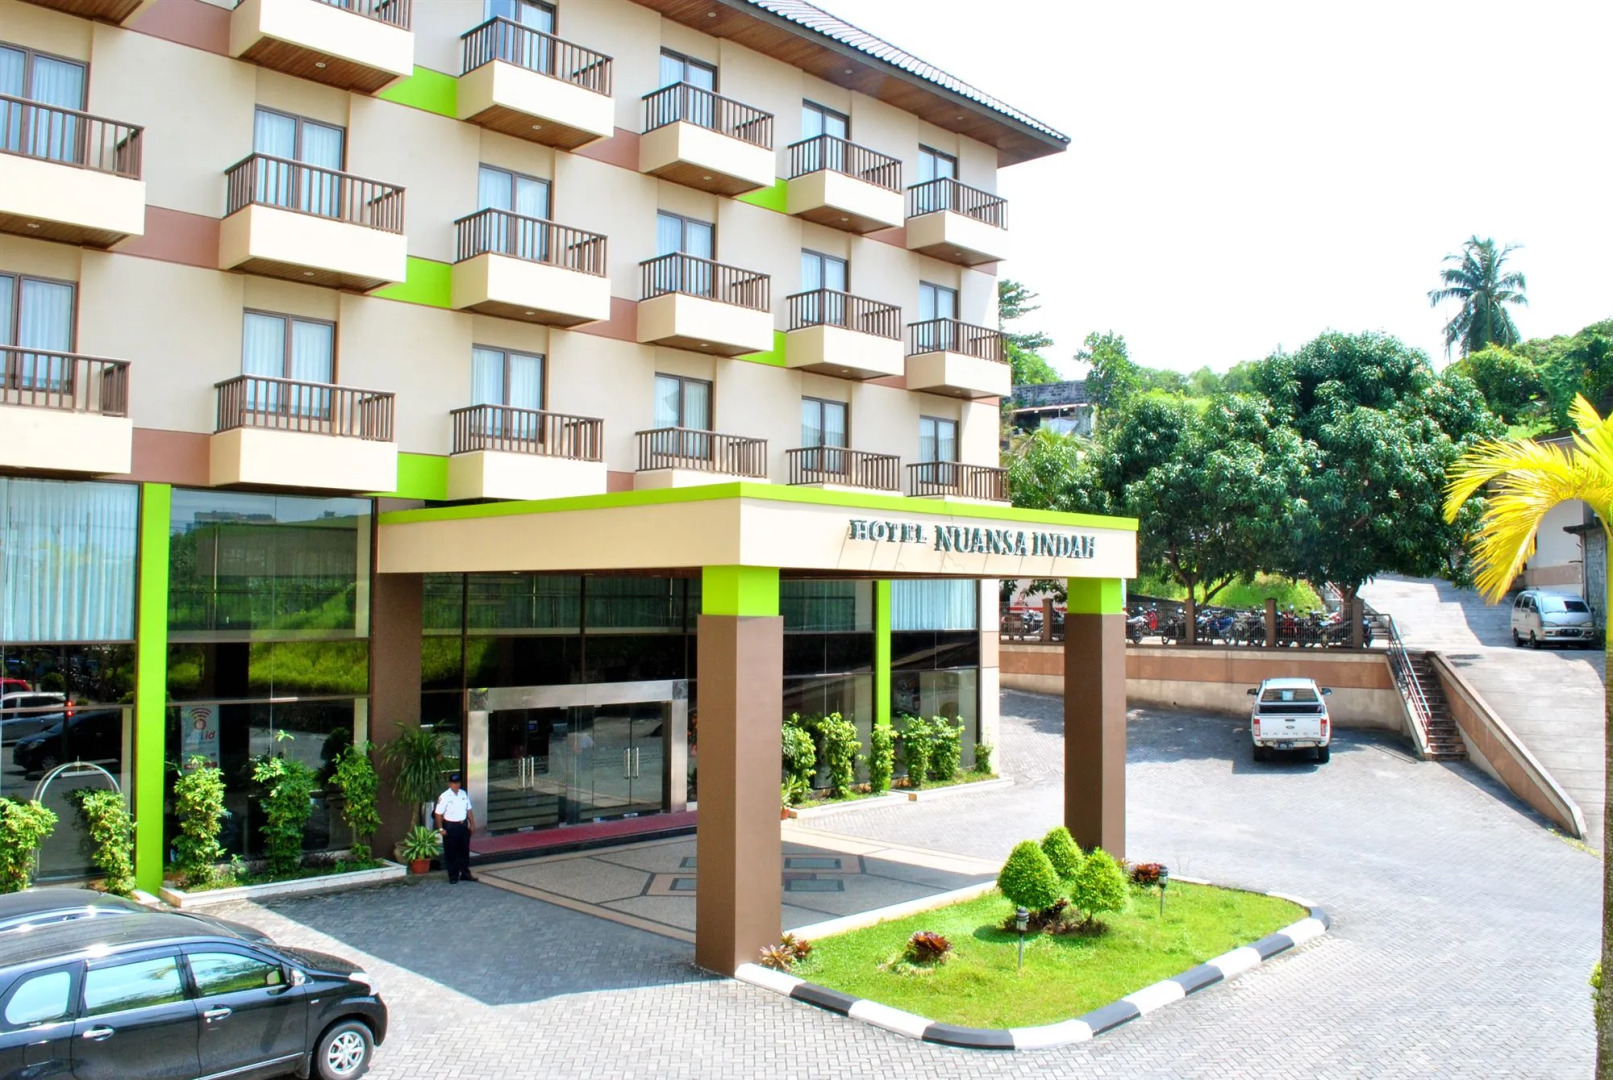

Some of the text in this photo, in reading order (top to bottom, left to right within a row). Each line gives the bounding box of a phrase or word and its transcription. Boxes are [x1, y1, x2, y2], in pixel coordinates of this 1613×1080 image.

[849, 519, 1096, 559] HOTEL NUANSA INDAH
